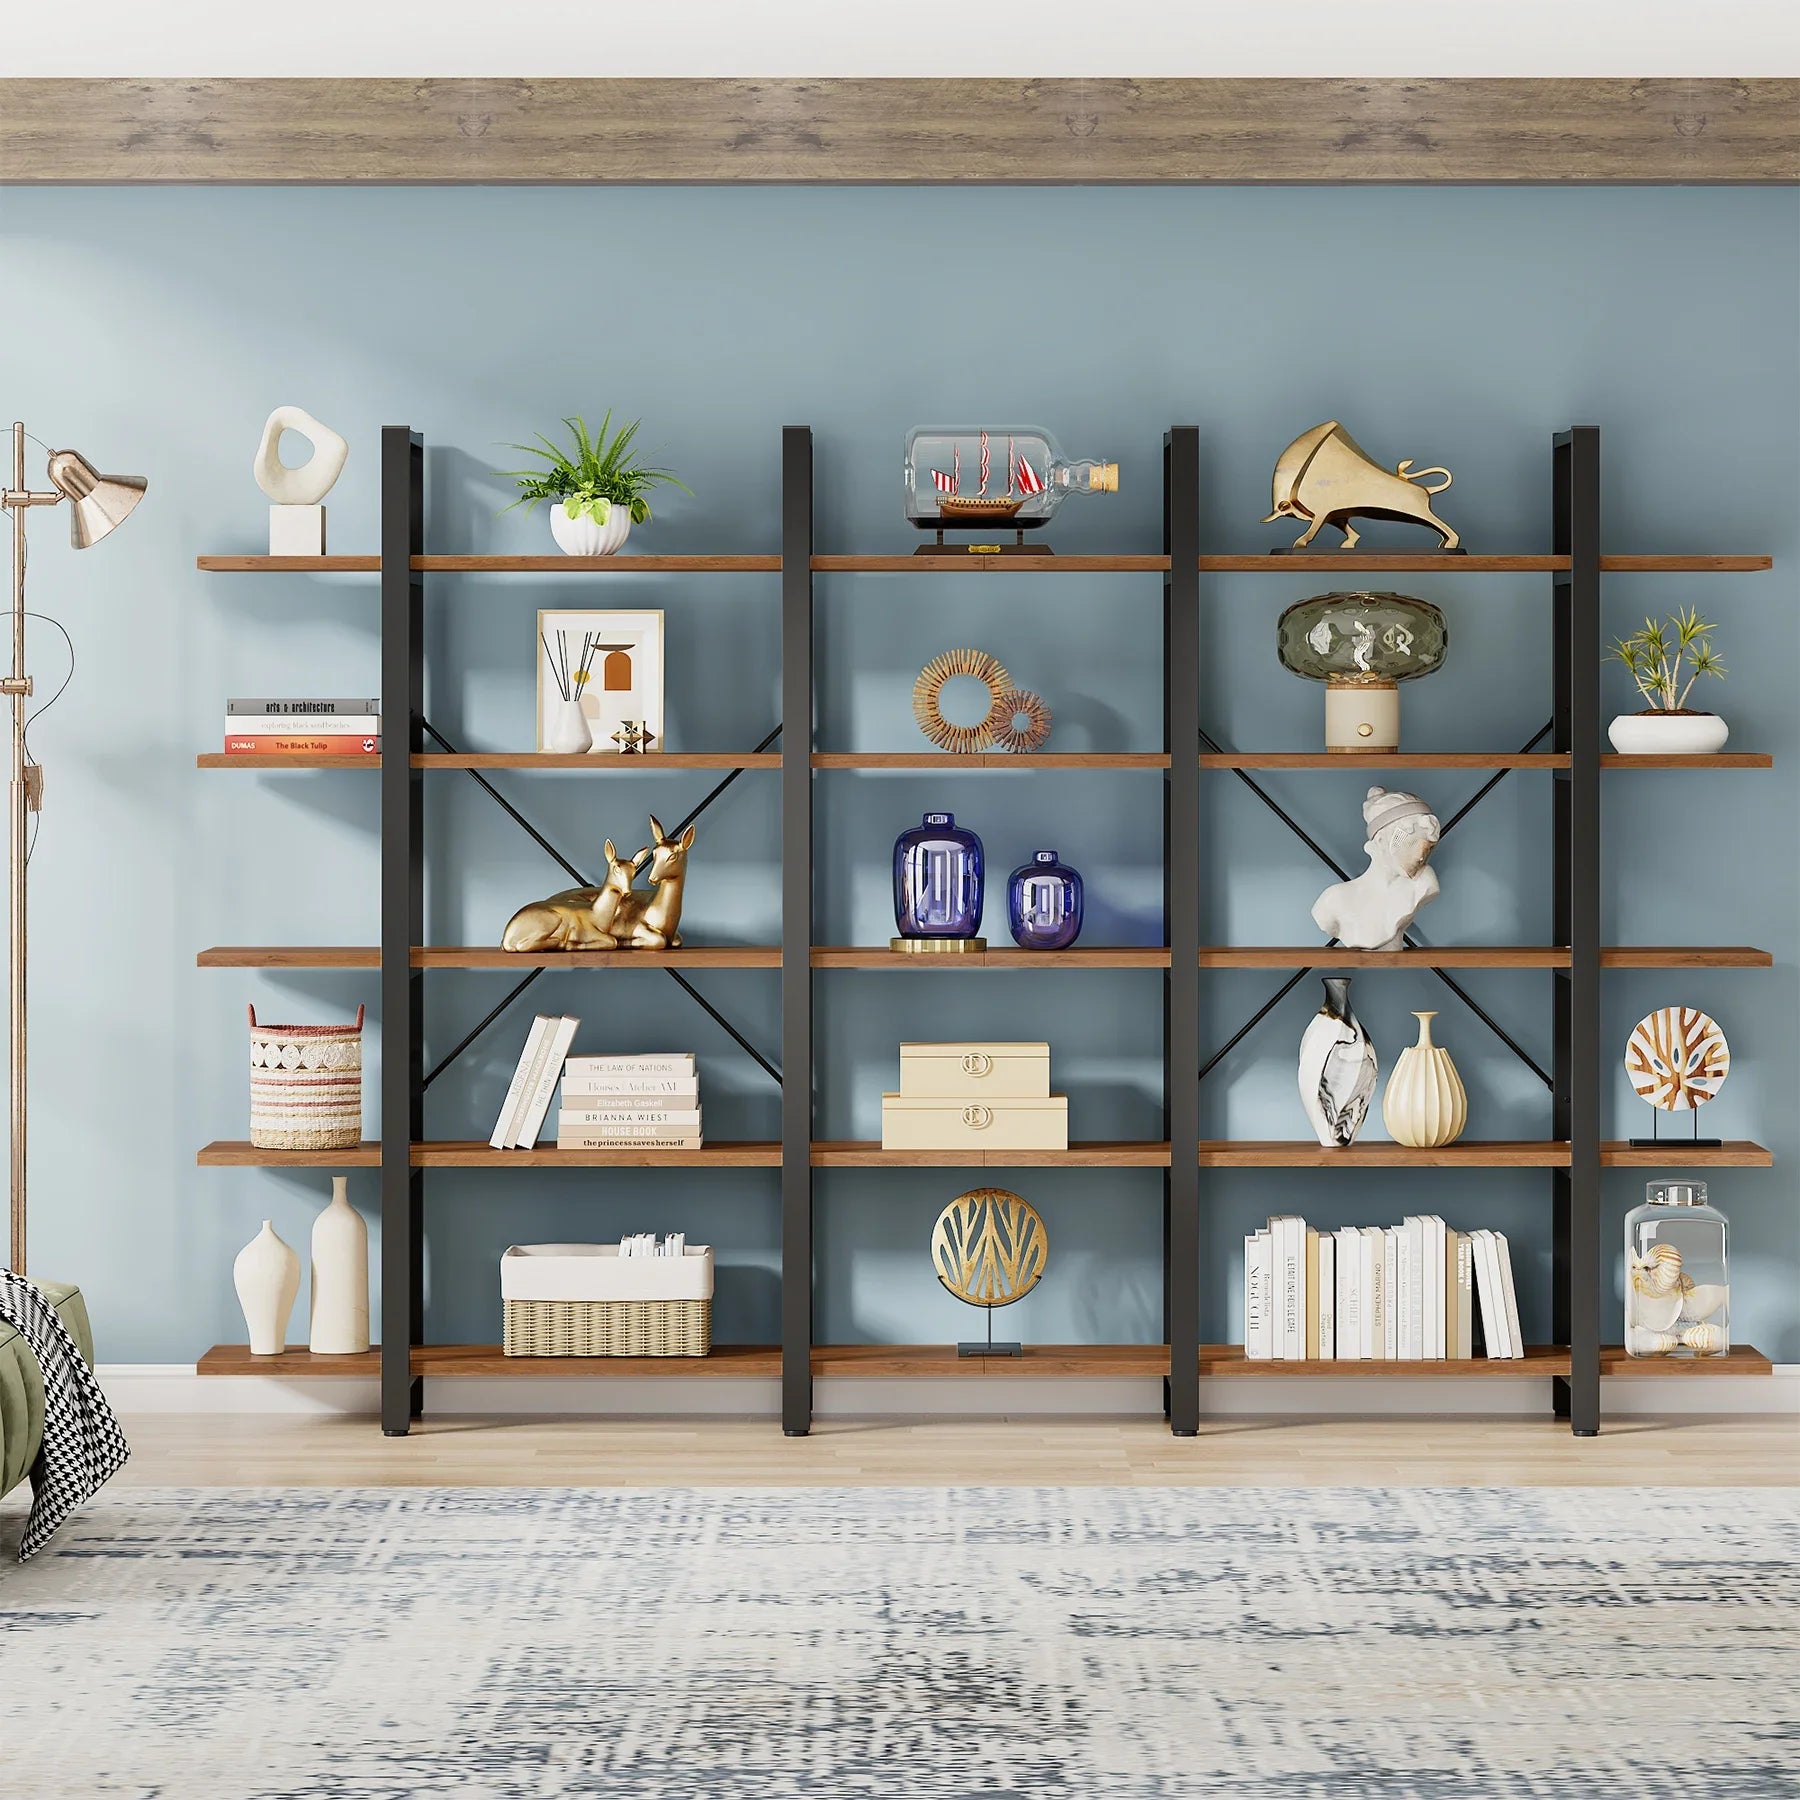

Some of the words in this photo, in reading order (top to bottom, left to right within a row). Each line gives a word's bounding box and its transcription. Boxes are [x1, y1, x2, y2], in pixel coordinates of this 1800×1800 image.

[265, 702, 280, 713] arts
[291, 701, 335, 713] architecture
[261, 721, 290, 731] exploring
[275, 742, 288, 750] The
[290, 742, 309, 750] Black
[311, 742, 328, 751] Tulip
[589, 1064, 604, 1072] THE
[607, 1064, 624, 1072] LAW
[626, 1064, 637, 1072] OF
[639, 1064, 673, 1072] NATIONS
[535, 1096, 547, 1107] THE
[596, 1099, 632, 1107] Elizabeth
[633, 1099, 663, 1107] Gaskell
[601, 1126, 632, 1137] HOUSE
[633, 1126, 657, 1137] BOOK
[1374, 1263, 1382, 1293] MARINO
[1374, 1293, 1382, 1327] STEPHEN
